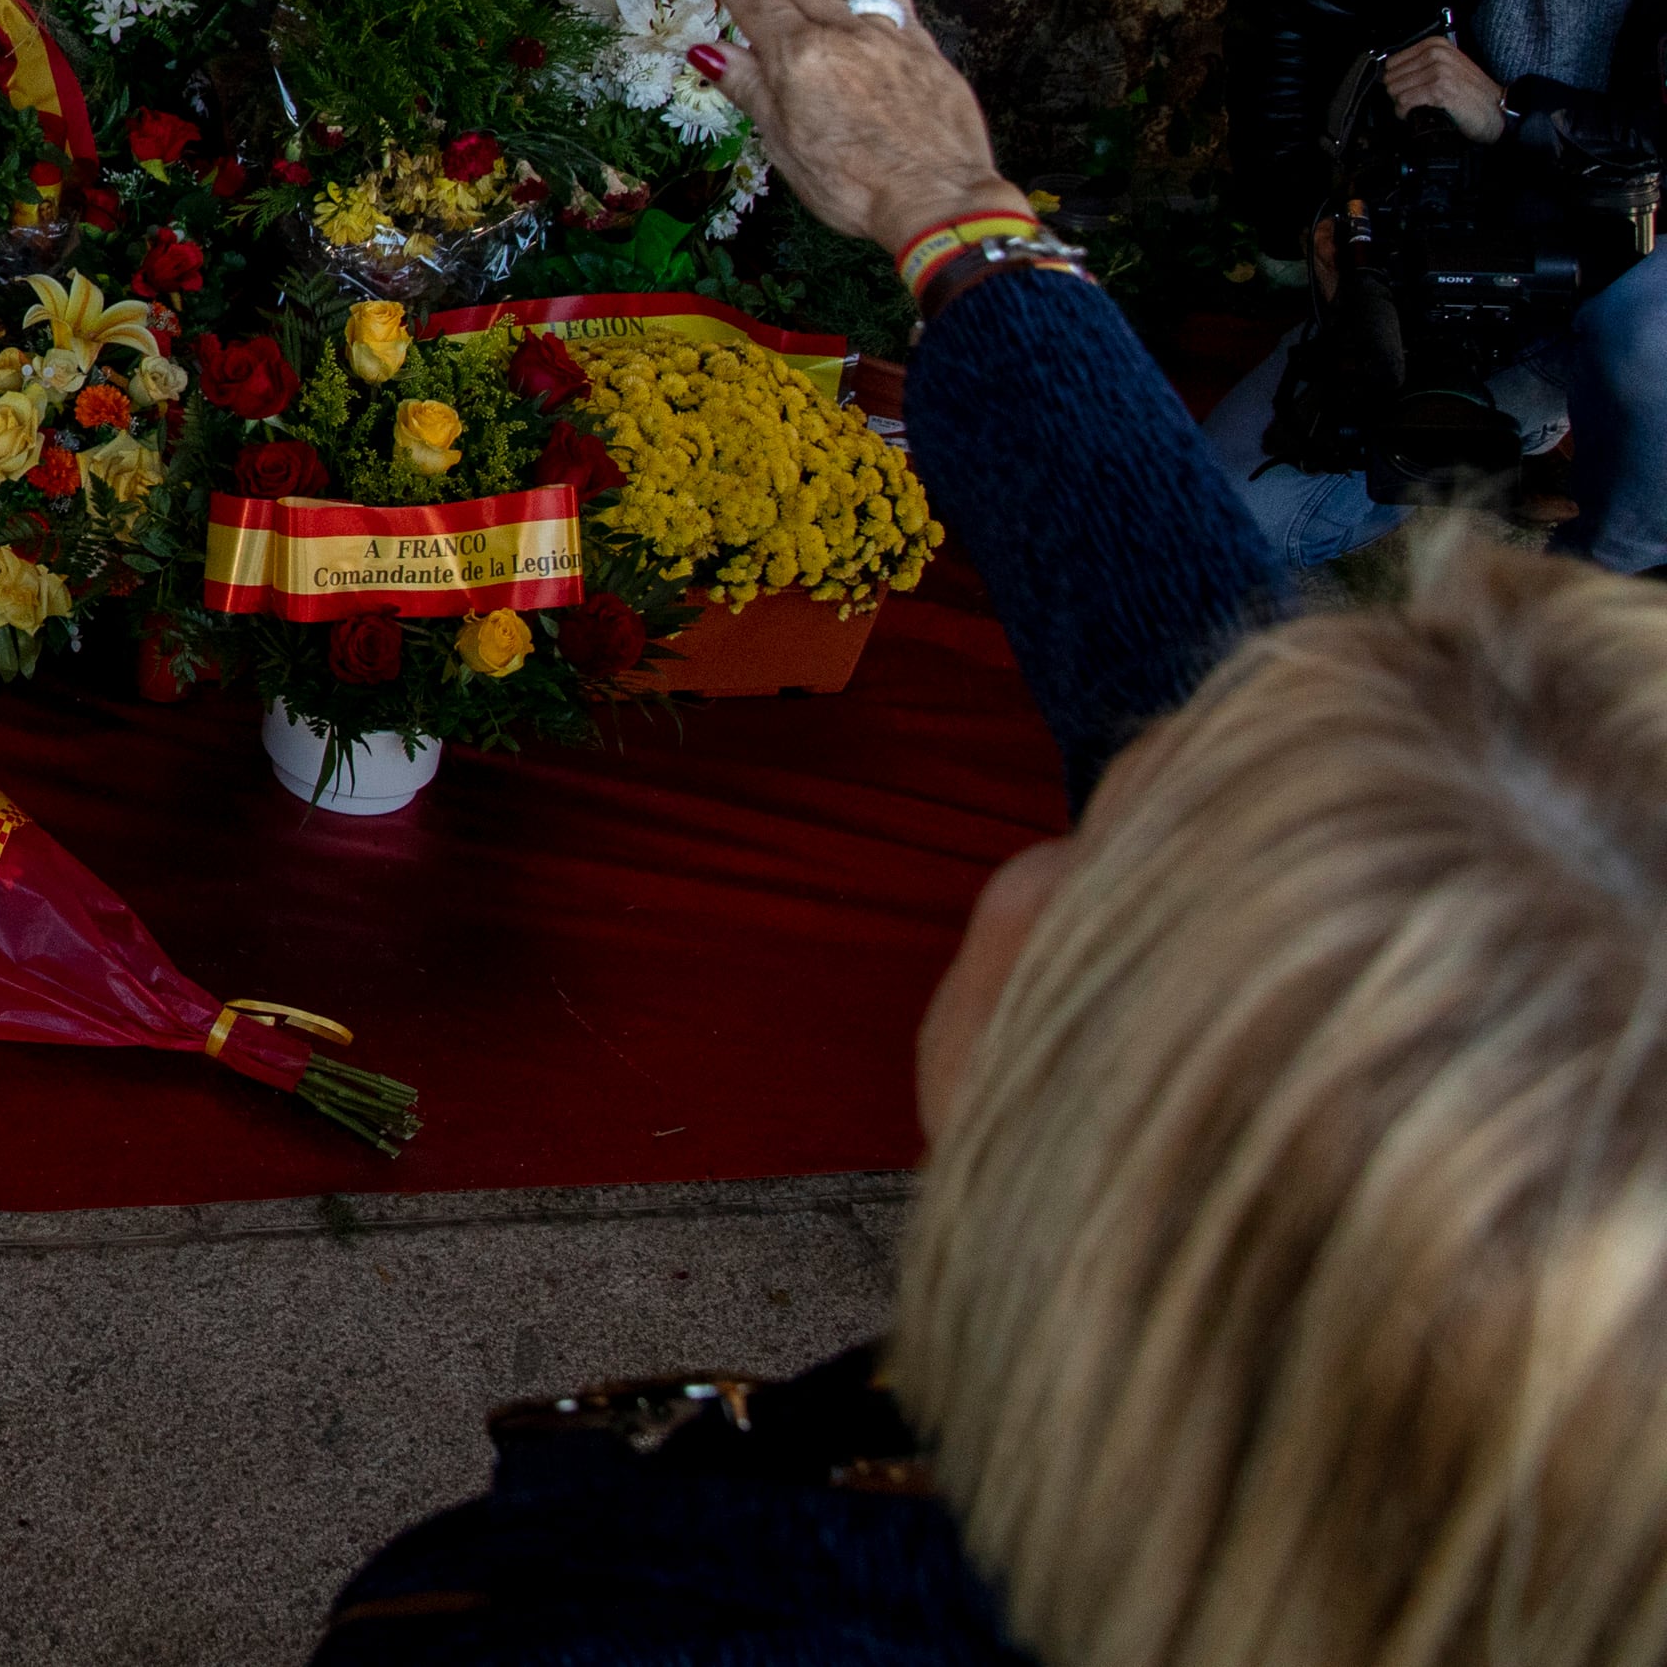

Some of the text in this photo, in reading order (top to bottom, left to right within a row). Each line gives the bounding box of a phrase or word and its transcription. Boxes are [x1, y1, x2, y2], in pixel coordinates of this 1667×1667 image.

[364, 533, 486, 560] A FRANCO
[313, 548, 583, 588] Comandante de la Legión
